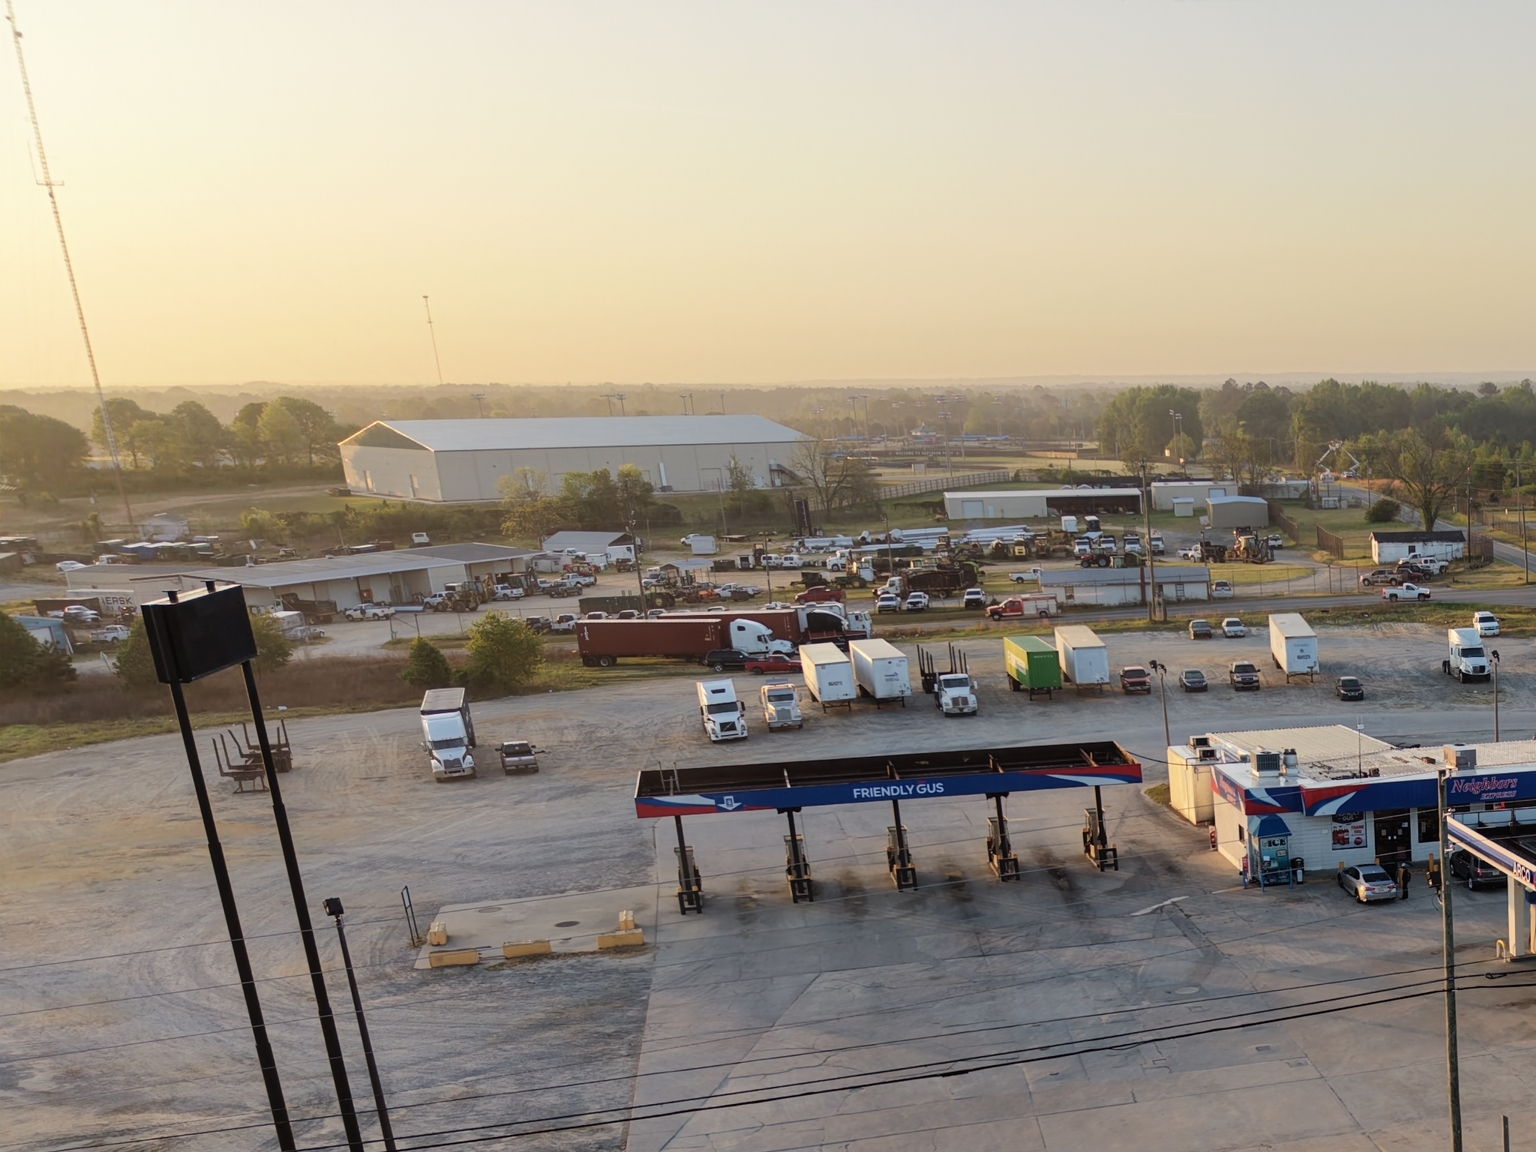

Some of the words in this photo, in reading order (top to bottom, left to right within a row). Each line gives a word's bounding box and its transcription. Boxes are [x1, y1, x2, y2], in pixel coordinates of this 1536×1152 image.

[101, 597, 133, 605] ERSK
[853, 784, 915, 799] FRIENDLY
[916, 782, 944, 794] GUS
[1451, 777, 1518, 794] Neighbors
[1267, 838, 1286, 847] ICE
[1513, 861, 1531, 883] ARCO
